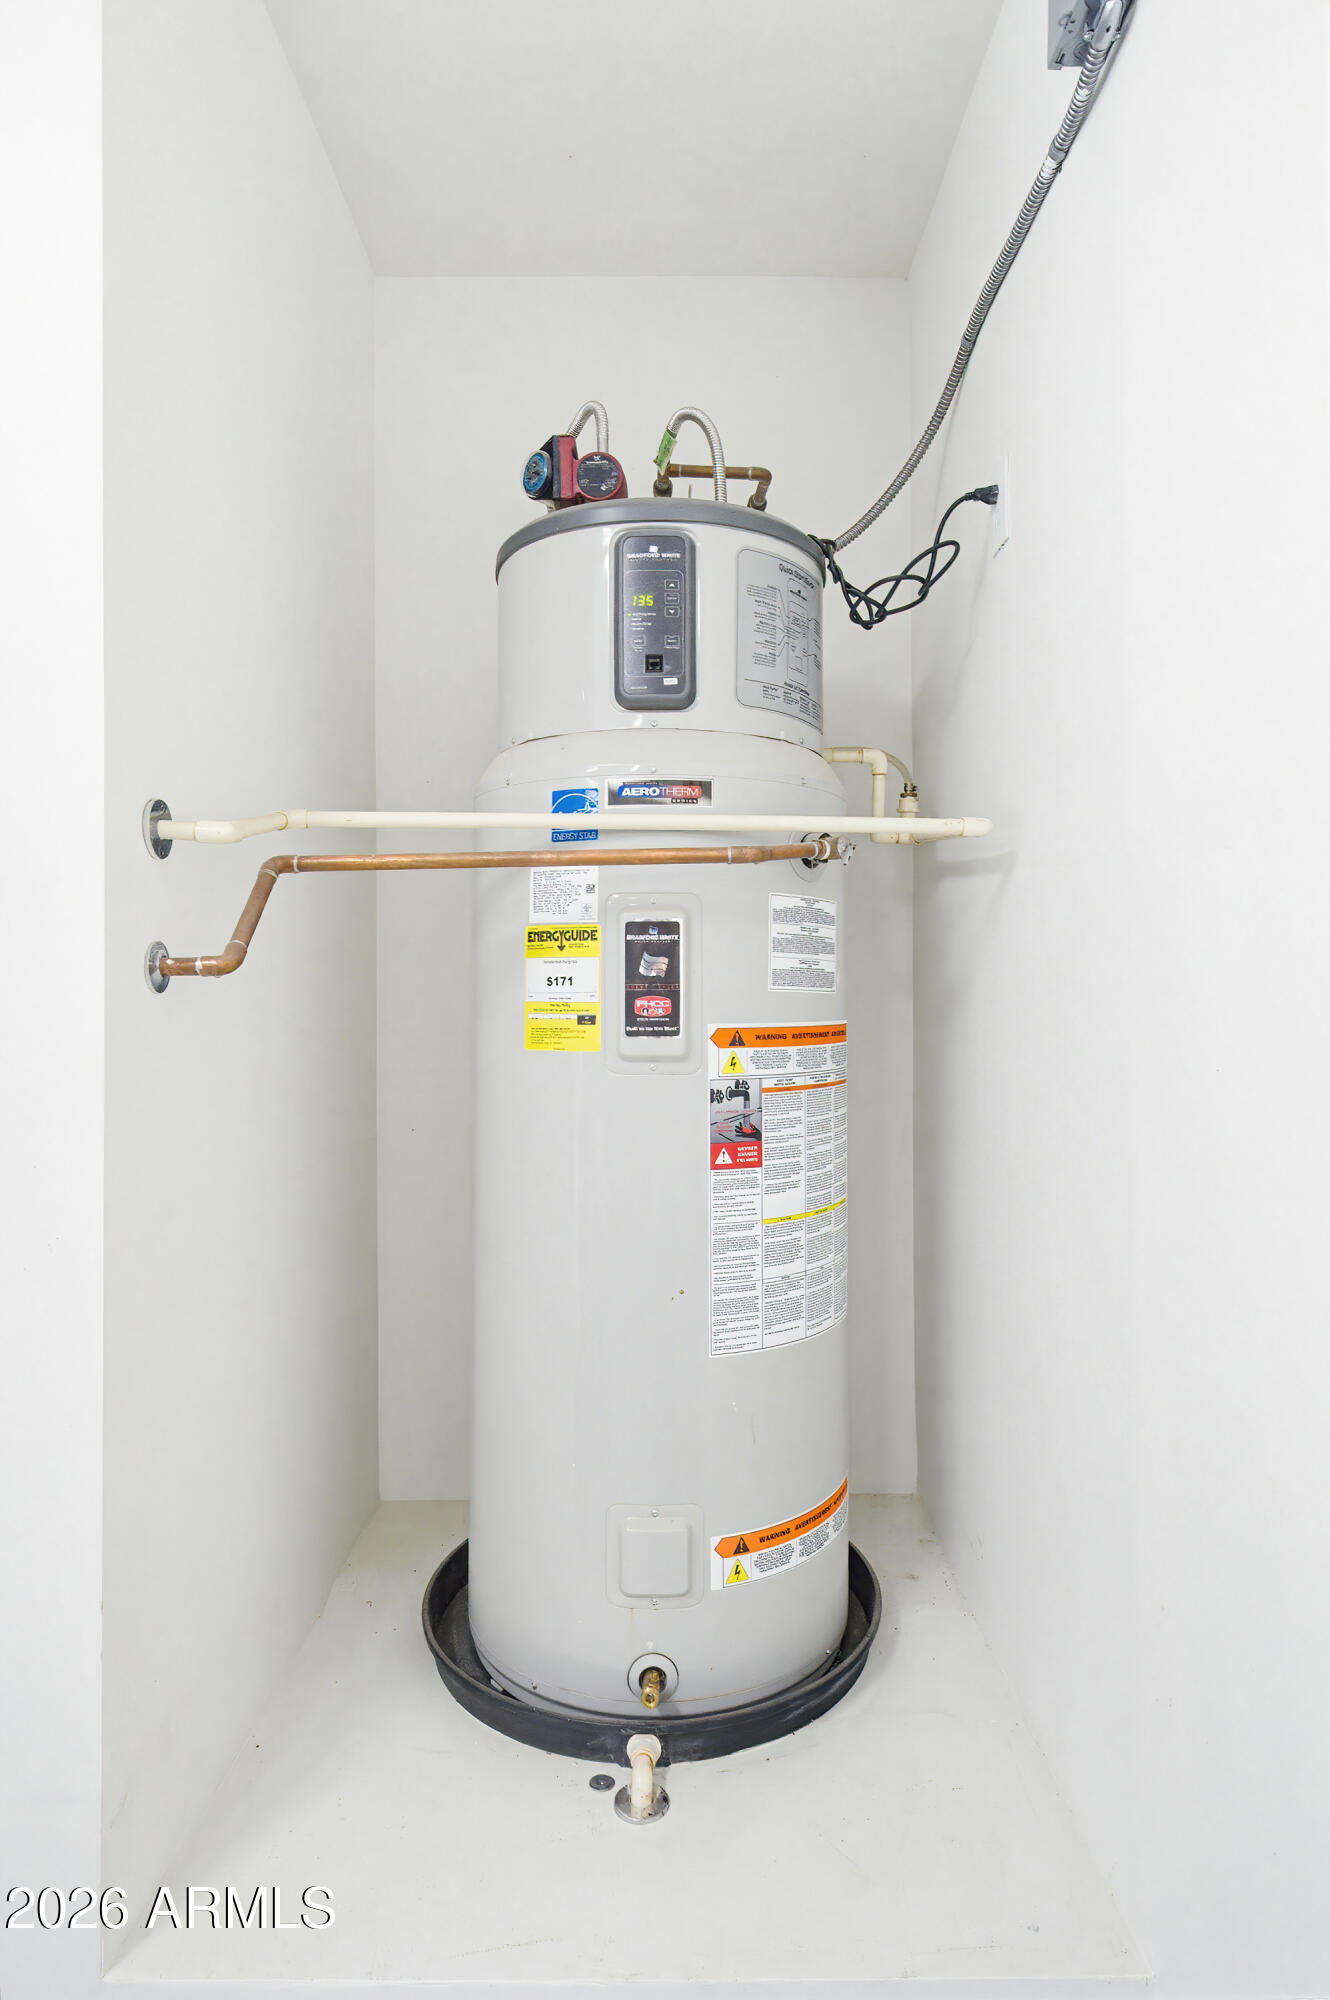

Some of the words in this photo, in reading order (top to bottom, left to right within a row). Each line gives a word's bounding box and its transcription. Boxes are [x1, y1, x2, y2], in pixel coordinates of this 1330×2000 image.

[632, 595, 654, 606] 135
[621, 786, 699, 796] AEROTHERM
[527, 930, 598, 943] ENERGYGUIDE
[546, 976, 573, 987] $171
[755, 1033, 787, 1041] WARNING
[759, 1527, 791, 1543] WARNING
